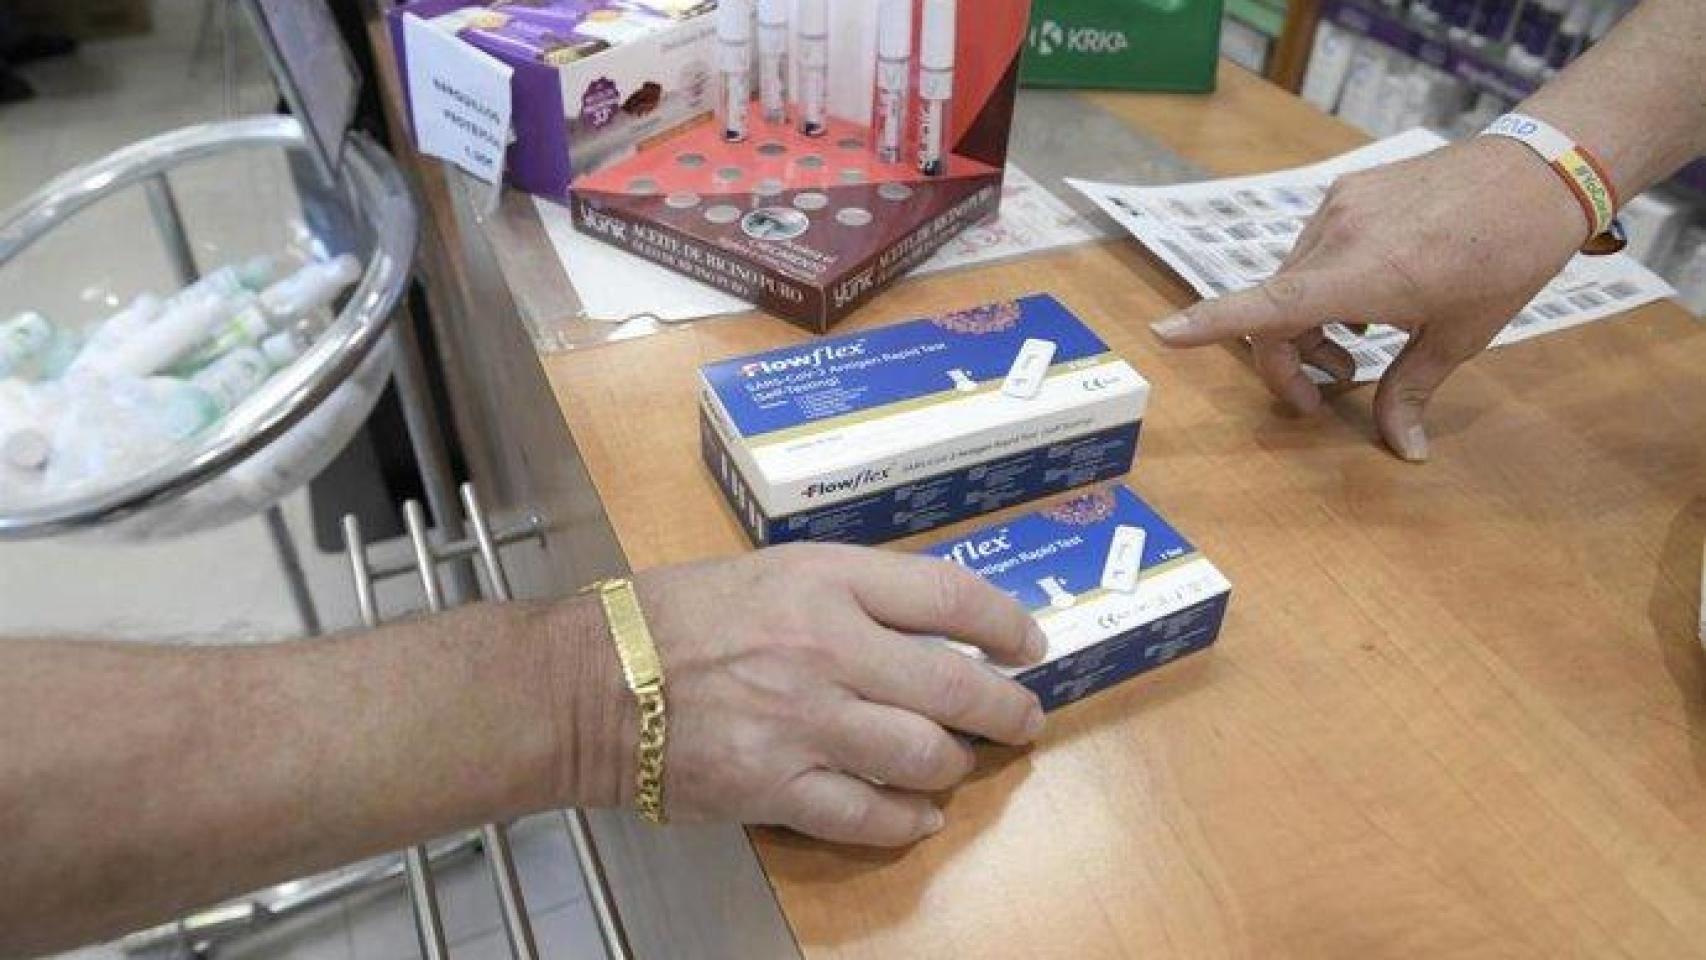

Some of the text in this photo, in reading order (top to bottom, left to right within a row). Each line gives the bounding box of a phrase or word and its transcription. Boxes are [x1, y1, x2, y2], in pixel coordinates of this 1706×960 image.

[1066, 28, 1128, 53] KRKA
[741, 344, 862, 375] Flowflex
[744, 342, 947, 393] SARS-CoV-2 Antigen Rapid Test
[801, 465, 890, 498] Flowflex
[944, 536, 1012, 567] flex
[1018, 543, 1056, 562] Rapid
[1056, 536, 1084, 550] Test
